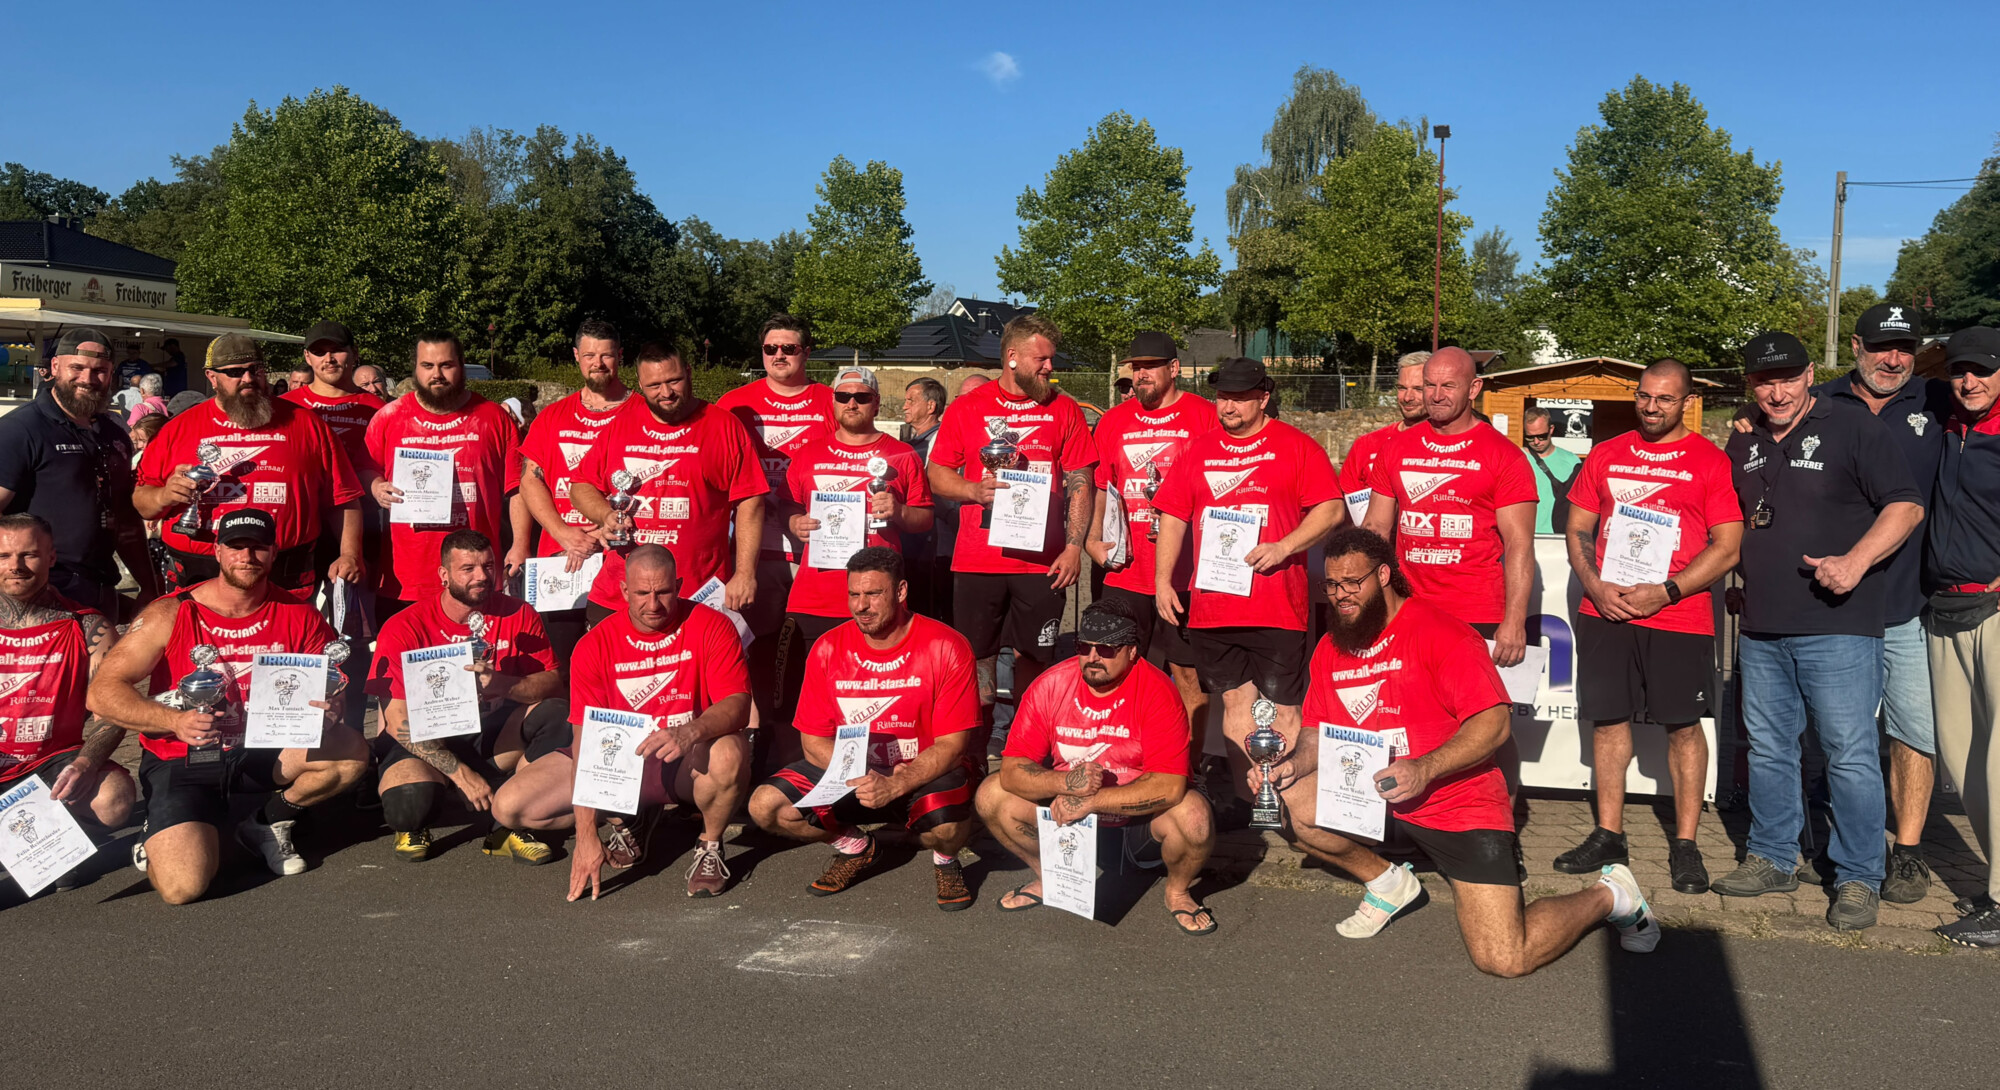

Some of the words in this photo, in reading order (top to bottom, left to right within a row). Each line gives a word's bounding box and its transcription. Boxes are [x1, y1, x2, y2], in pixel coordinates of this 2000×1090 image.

[12, 270, 71, 298] Freiberger
[115, 283, 167, 308] Freiberger
[1880, 321, 1910, 329] FITGIANT
[754, 413, 824, 421] www.all-stars.de
[200, 433, 286, 444] www.all-stars.de
[401, 432, 479, 444] www.all-stars.de
[767, 430, 792, 447] MILDE
[1122, 429, 1189, 440] www.all-stars.de
[400, 450, 449, 461] URKUNDE
[625, 445, 699, 454] www.all-stars.de
[214, 450, 247, 471] MILDE
[1204, 451, 1276, 467] www.all-stars.de
[1402, 457, 1481, 470] www.all-stars.de
[1791, 459, 1824, 471] REFEREE
[1001, 471, 1047, 484] URKUNDE
[1609, 464, 1693, 481] www.all-stars.de
[1213, 474, 1241, 495] MILDE
[1408, 476, 1439, 498] MILDE
[815, 493, 861, 503] URKUNDE
[1432, 493, 1472, 505] Rittersaal
[226, 517, 265, 528] SMILODOX
[1208, 509, 1256, 525] URKUNDE
[1400, 510, 1436, 529] ATX
[1618, 505, 1673, 528] URKUNDE
[1441, 518, 1472, 531] BETON
[219, 642, 285, 656] all-stars.de
[407, 646, 466, 664] URKUNDE
[258, 656, 322, 668] URKUNDE
[615, 649, 692, 672] www.all-stars.de
[836, 675, 921, 690] www.all-stars.de
[630, 676, 661, 707] MILDE
[10, 695, 56, 706] Rittersaal
[850, 700, 882, 725] MILDE
[1518, 705, 1541, 717] BY
[588, 710, 645, 728] URKUNDE
[876, 720, 916, 731] Rittersaal
[1324, 726, 1384, 748] URKUNDE
